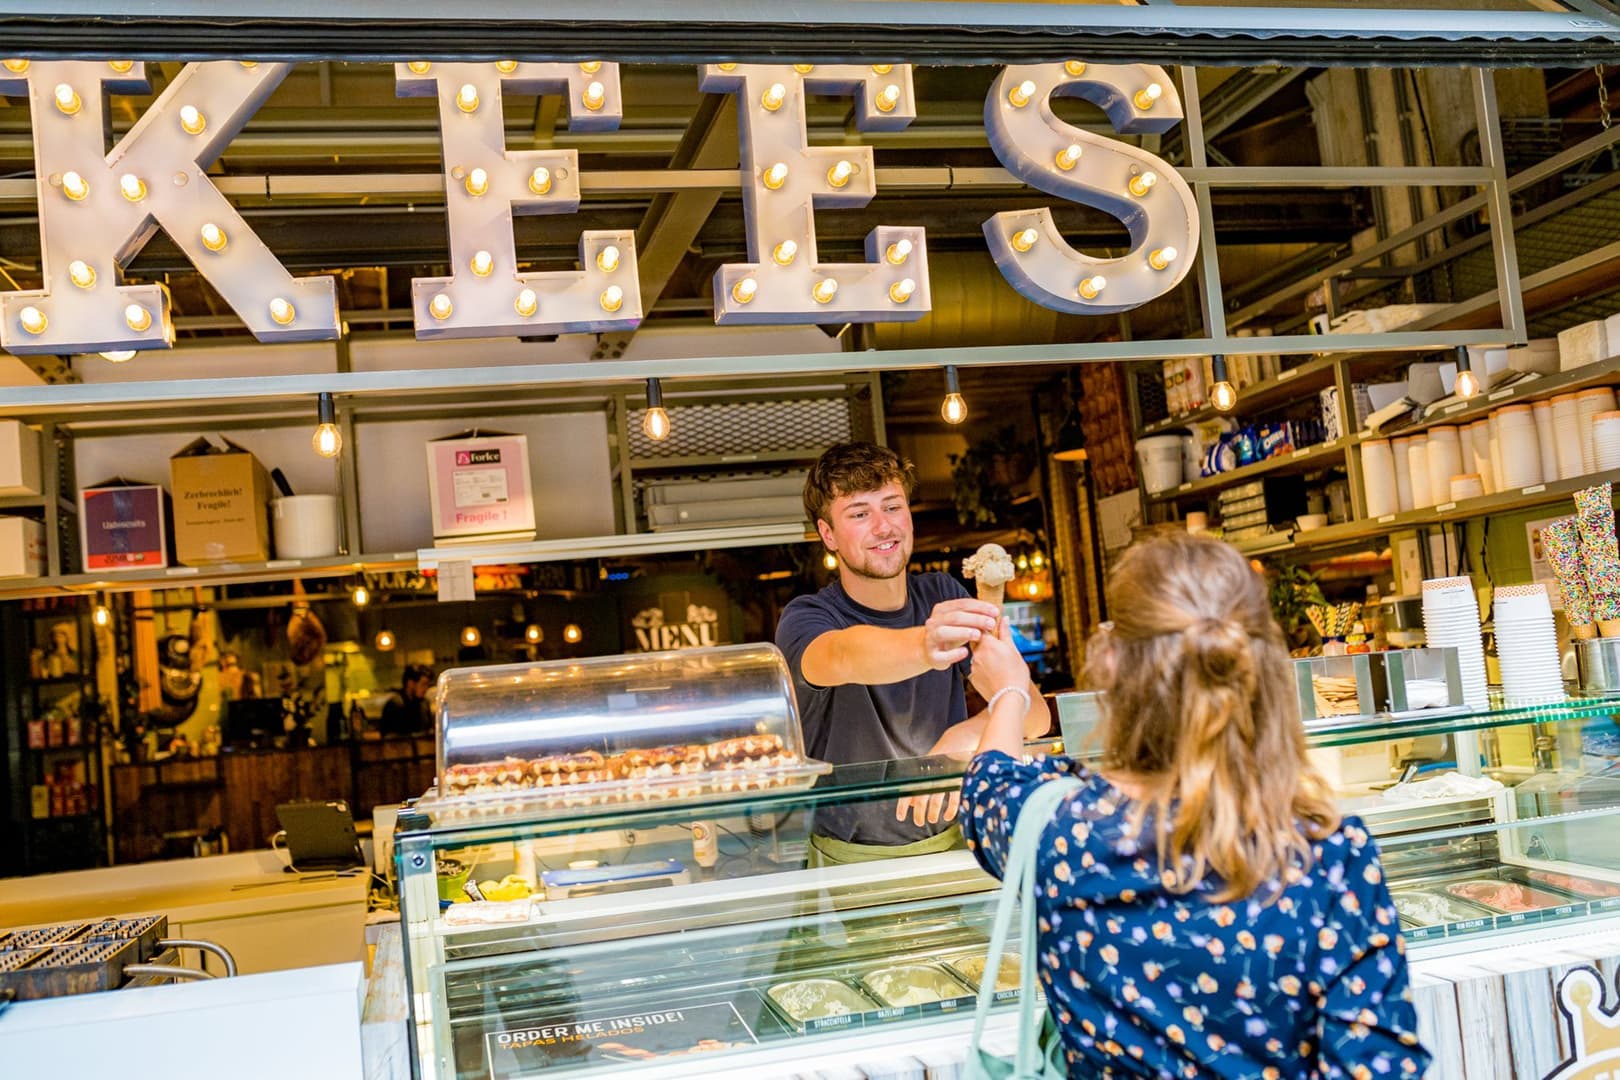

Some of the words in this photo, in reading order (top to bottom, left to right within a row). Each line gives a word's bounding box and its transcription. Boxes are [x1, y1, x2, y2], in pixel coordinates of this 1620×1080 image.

[0, 62, 1200, 355] KEES
[455, 511, 500, 525] Fragile
[635, 622, 719, 652] MENU
[497, 1027, 569, 1045] ORDER
[574, 1022, 602, 1037] ME
[611, 1011, 686, 1030] INSIDE!
[500, 1037, 558, 1050] TAPAS
[562, 1026, 645, 1043] HELADOS
